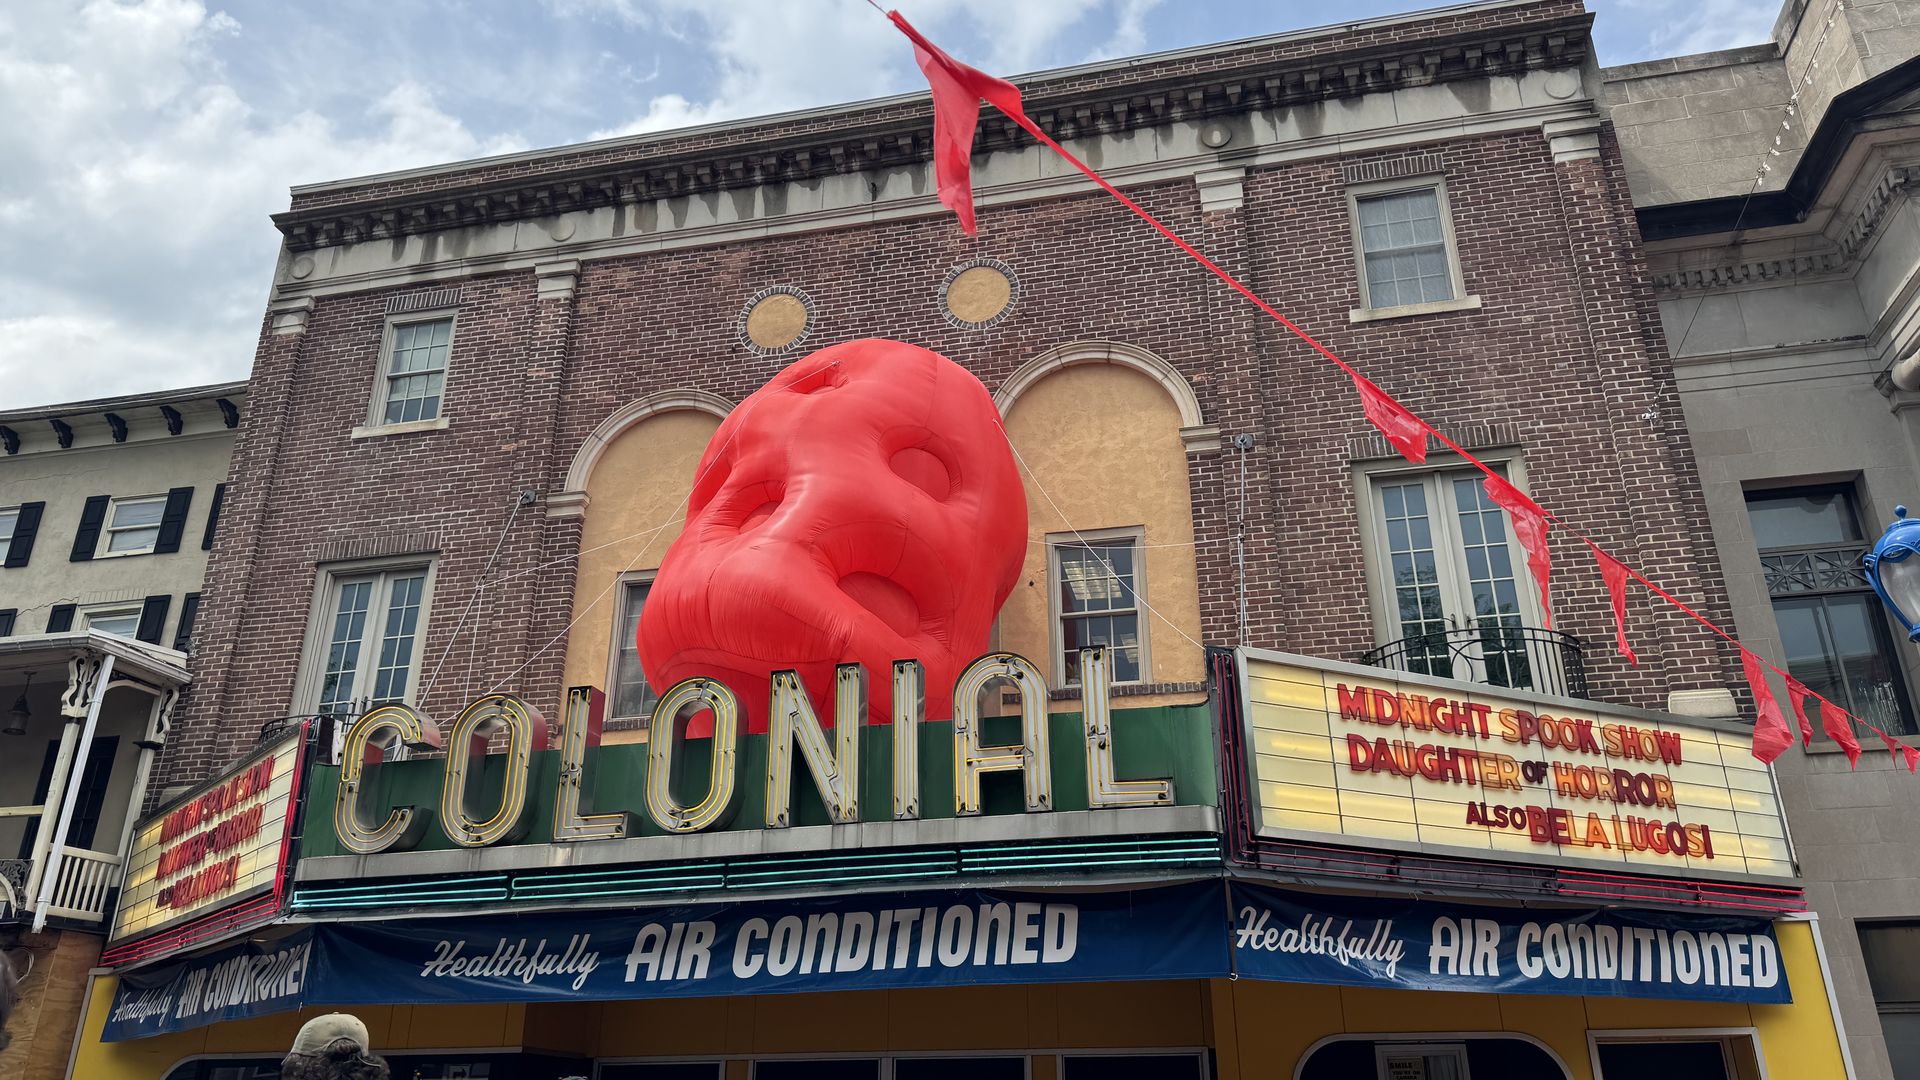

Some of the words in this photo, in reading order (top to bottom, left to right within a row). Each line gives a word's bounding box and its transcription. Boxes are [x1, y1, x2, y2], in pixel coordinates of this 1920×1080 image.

[334, 645, 1176, 856] COLONIAL
[1336, 683, 1492, 740] MIDNIGHT
[1498, 708, 1602, 755] SPOOK
[1603, 723, 1682, 766] SHOW
[1346, 733, 1523, 791] DAUGHTER
[1521, 760, 1549, 784] OF
[1553, 761, 1677, 810] HORROR
[1466, 801, 1527, 831] ALSO
[1526, 805, 1612, 850] BELA
[1611, 814, 1715, 860] LUGOSI
[420, 933, 600, 991] Healthfully
[624, 920, 717, 983] AIR
[732, 903, 1080, 979] CONDITIONED
[1236, 906, 1406, 978] Healthfully
[1428, 916, 1500, 977] AIR
[1516, 921, 1779, 989] CONDITIONED
[112, 987, 173, 1027] Healthfully
[175, 967, 207, 1019] AIR
